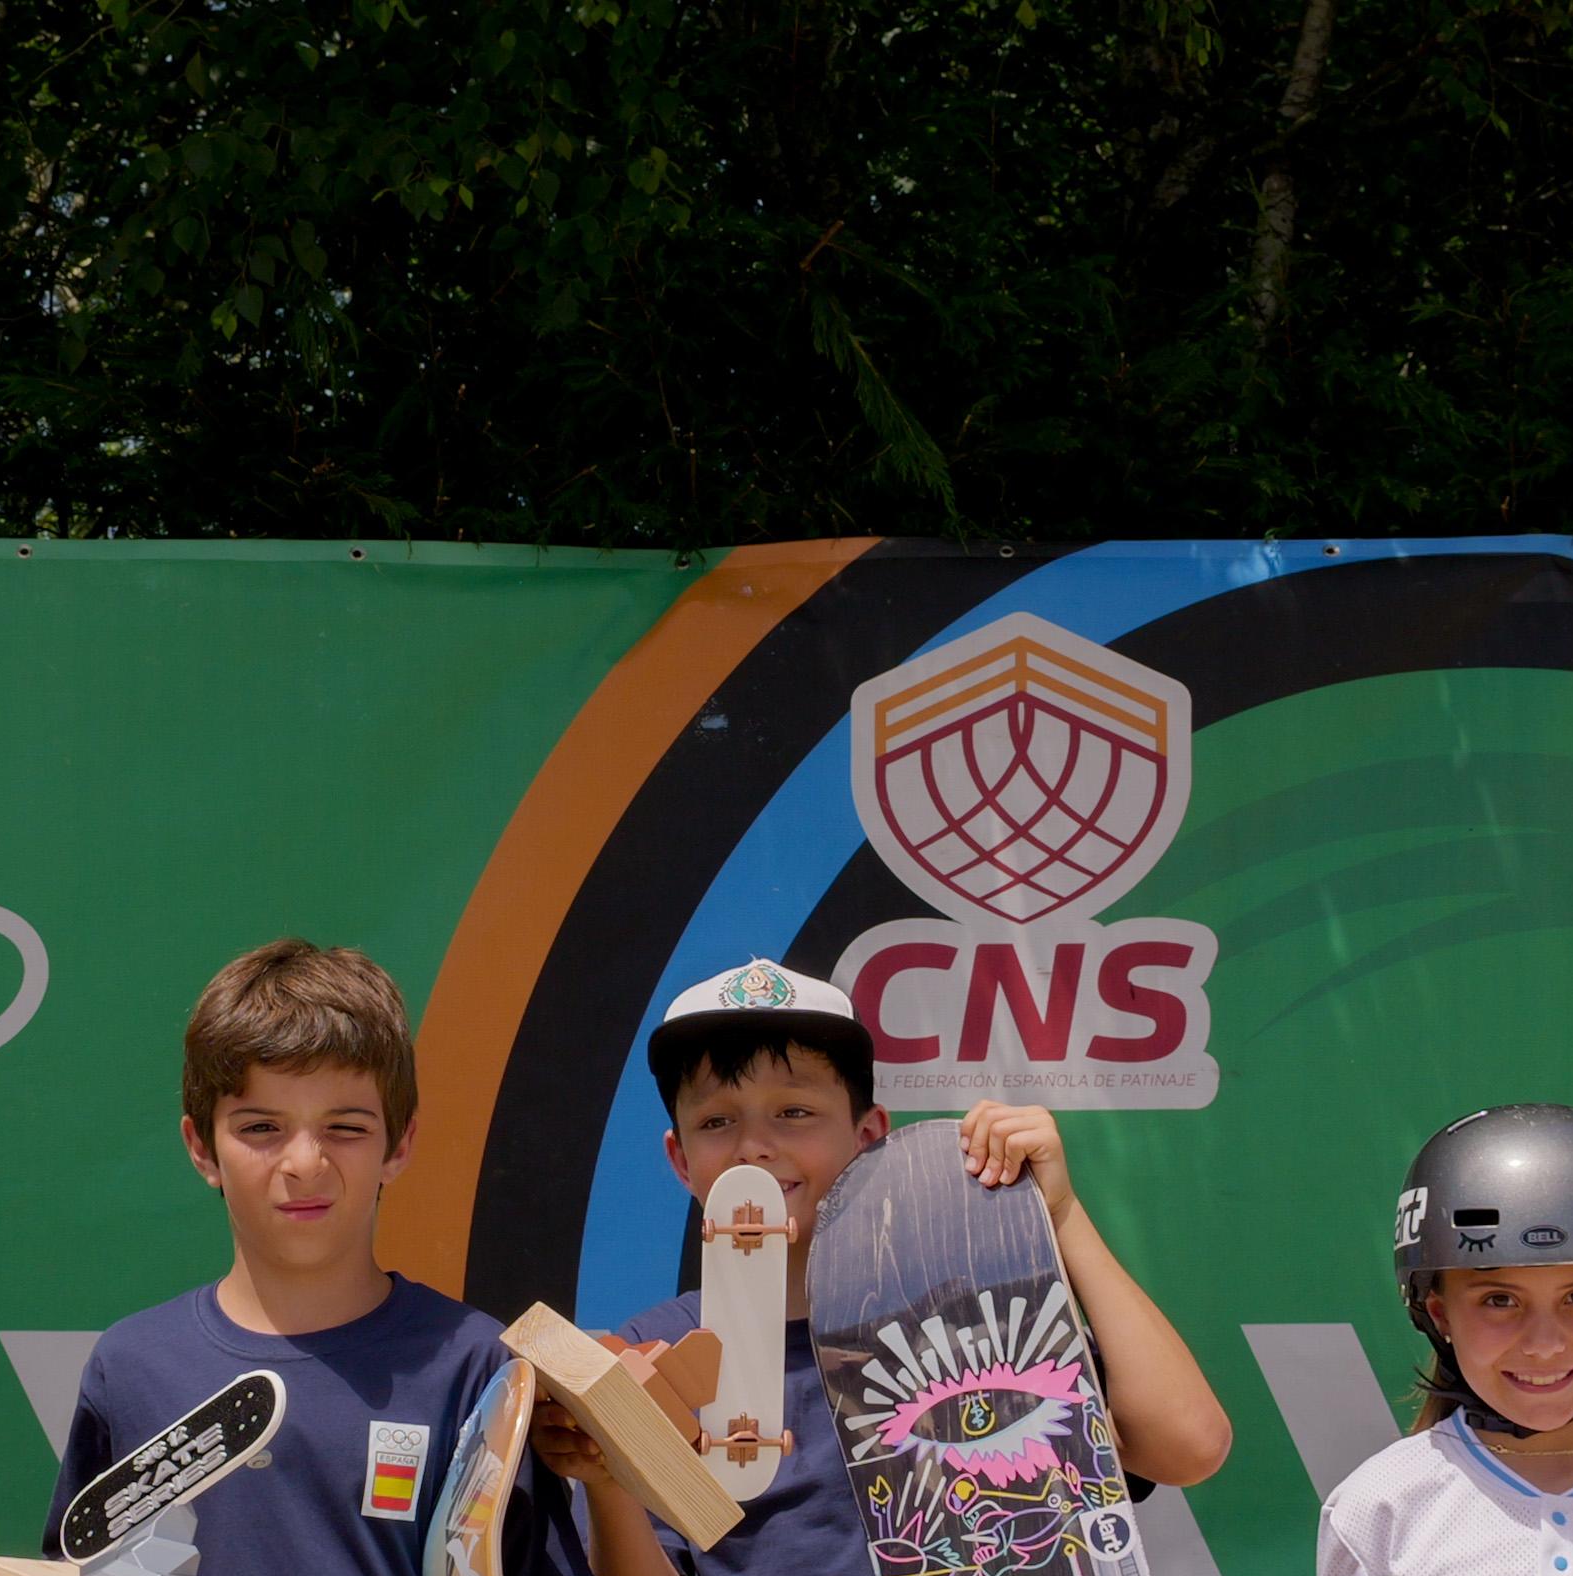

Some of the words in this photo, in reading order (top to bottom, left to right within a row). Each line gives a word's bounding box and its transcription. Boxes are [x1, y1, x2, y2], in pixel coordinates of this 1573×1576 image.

[851, 941, 1194, 1064] CNS
[893, 1072, 995, 1089] FEDERACIÓN
[1002, 1071, 1089, 1088] ESPAÑOLA
[1094, 1073, 1116, 1088] DE
[1120, 1073, 1196, 1088] PATINAJE
[1527, 1231, 1562, 1243] BELL
[104, 1422, 224, 1519] SKATE
[379, 1453, 415, 1465] ESPAÑA
[107, 1444, 227, 1539] SERIES
[1095, 1513, 1124, 1555] Jart
